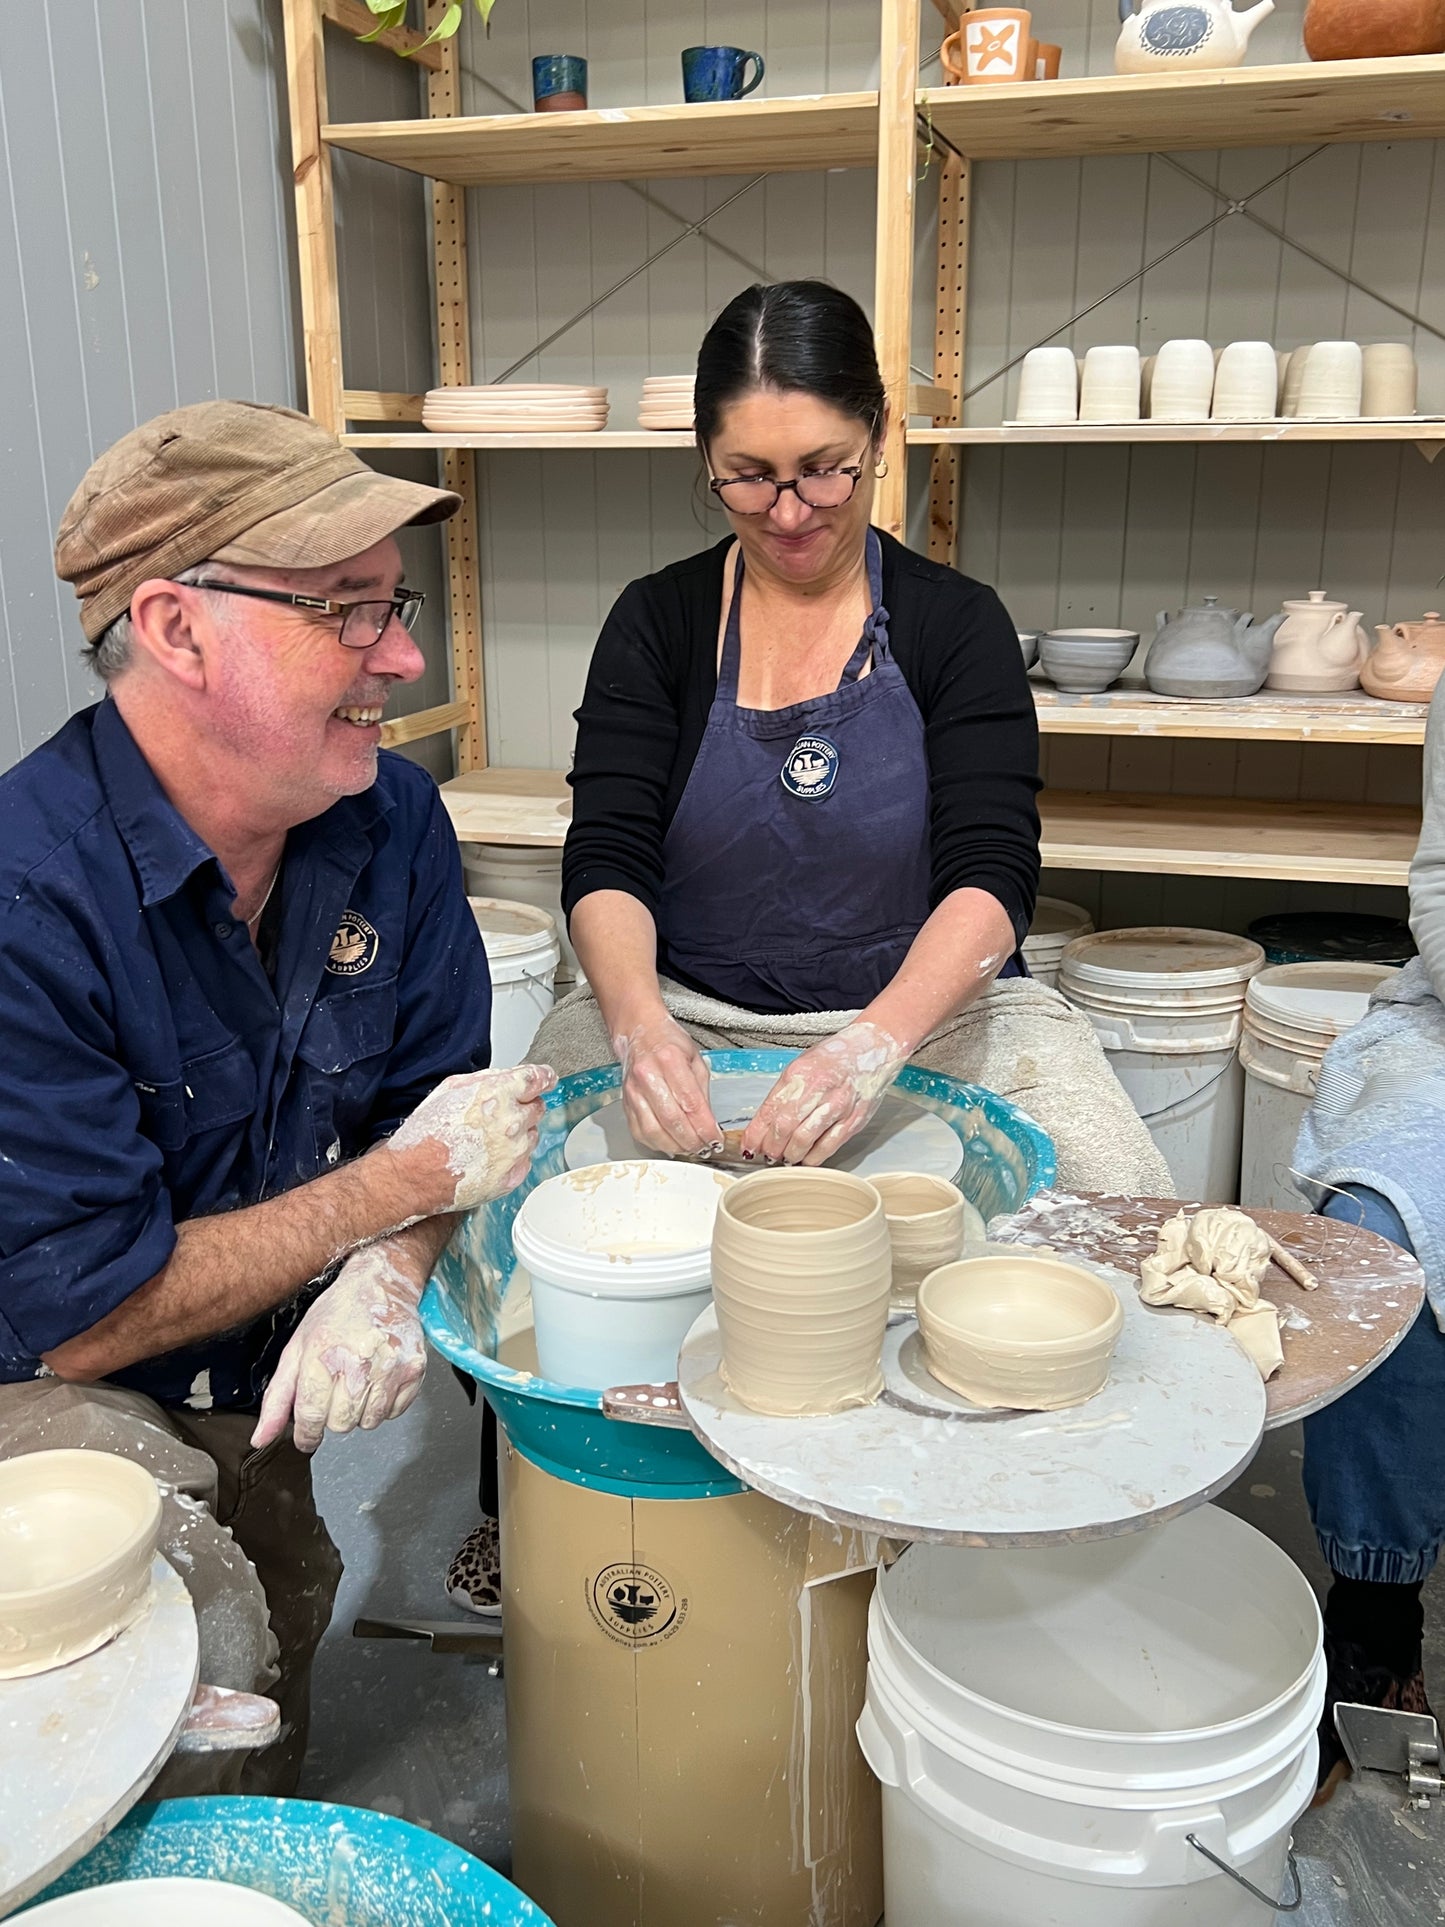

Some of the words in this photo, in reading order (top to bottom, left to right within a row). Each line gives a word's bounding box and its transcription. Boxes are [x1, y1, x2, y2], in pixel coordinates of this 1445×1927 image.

[811, 741, 836, 759] POTTERY
[348, 914, 373, 935] POTTERY
[331, 957, 368, 972] SUPPLIES
[599, 1569, 642, 1588] AUSTRALIAN
[644, 1571, 670, 1599] POTTERY
[608, 1616, 654, 1635] SUPPLIES
